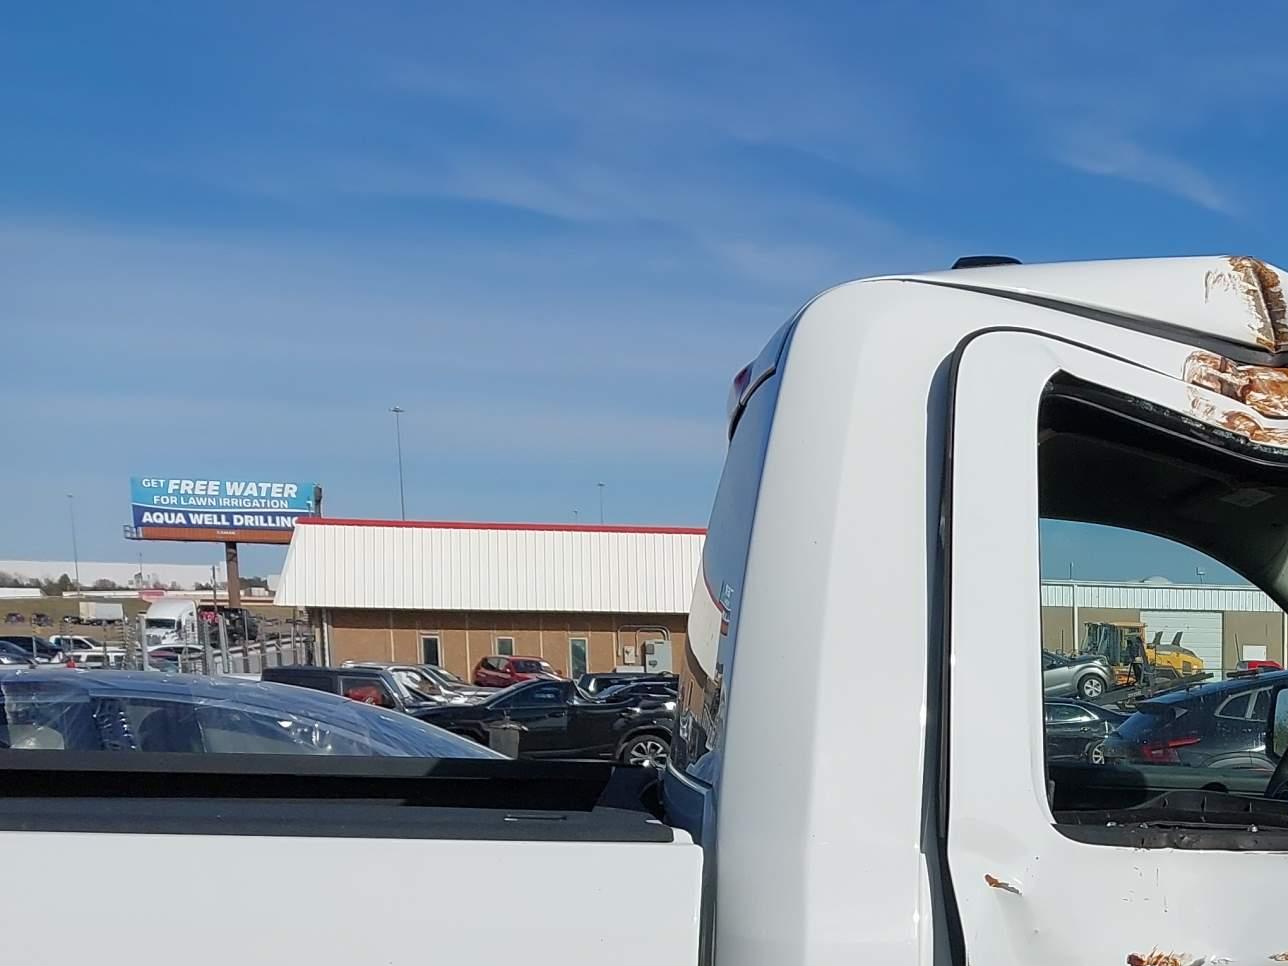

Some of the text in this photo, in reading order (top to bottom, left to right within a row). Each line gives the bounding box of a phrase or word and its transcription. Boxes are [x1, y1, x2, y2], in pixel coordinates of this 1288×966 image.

[142, 479, 298, 498] GET FREE WATER
[153, 495, 289, 509] FOR LAWN IRRIGATION
[141, 511, 187, 524] AQUA
[189, 514, 230, 526] WELL
